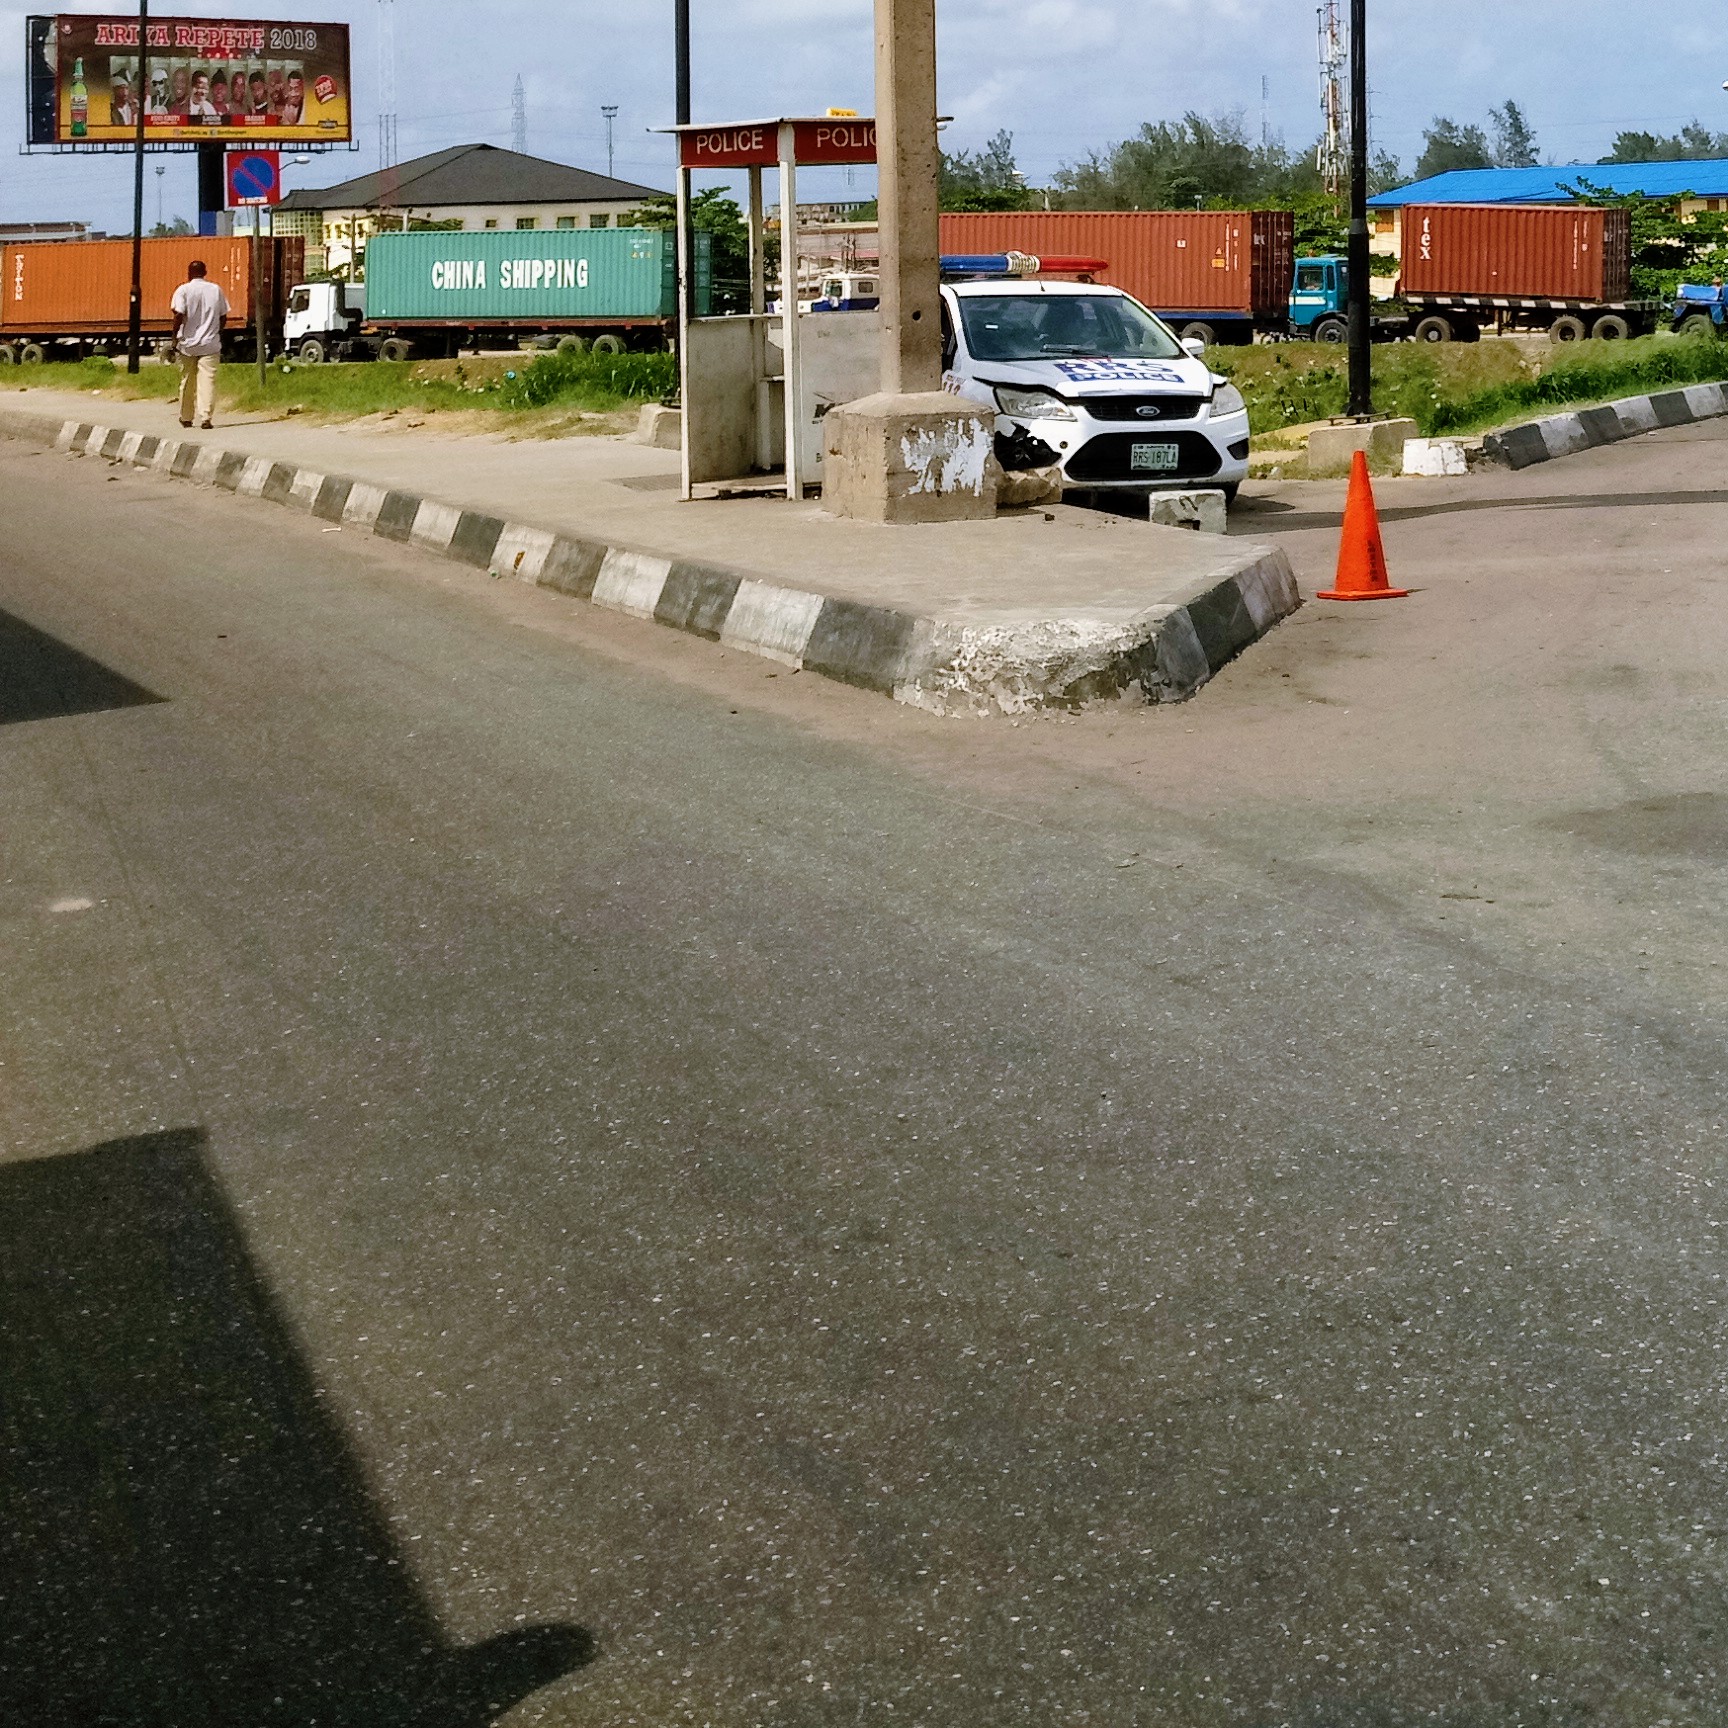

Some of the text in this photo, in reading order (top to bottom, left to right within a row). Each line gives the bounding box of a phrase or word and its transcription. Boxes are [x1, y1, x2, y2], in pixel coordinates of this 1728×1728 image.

[175, 26, 265, 49] REPETE
[270, 29, 317, 50] 2018
[696, 129, 763, 154] POLICE
[1420, 216, 1431, 259] tex
[431, 259, 588, 290] CHINA SHIPPING
[1053, 360, 1174, 373] RRS
[1072, 372, 1181, 383] POLICE
